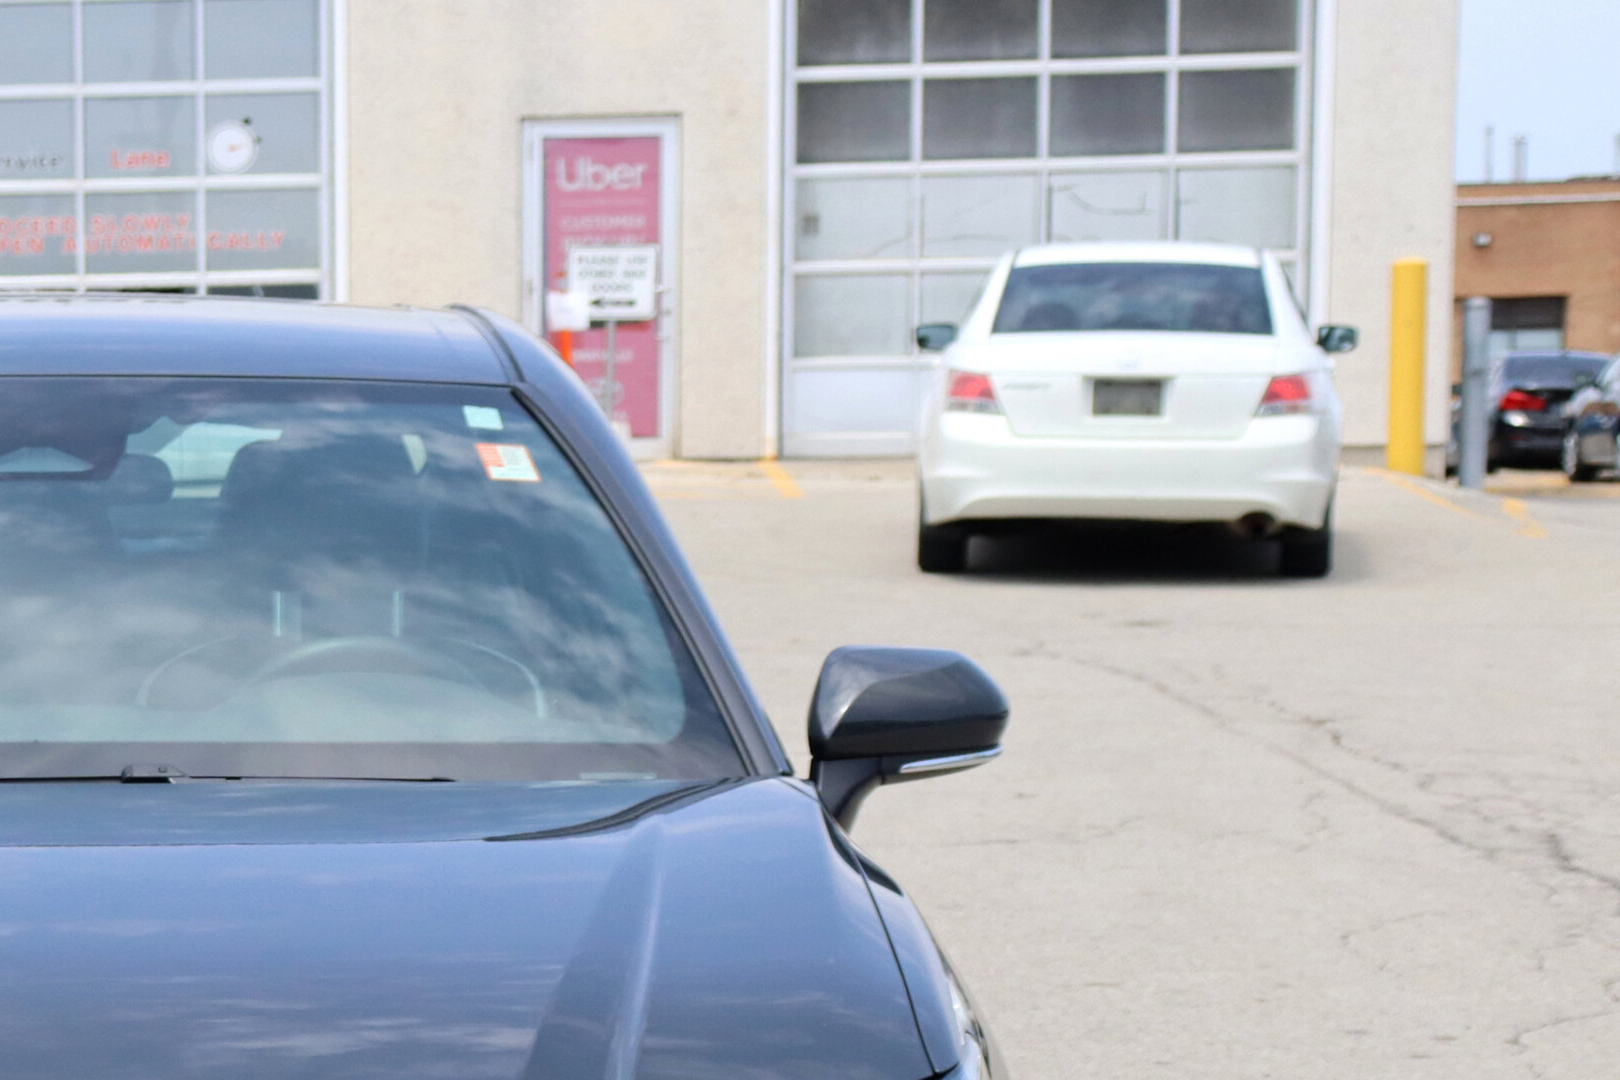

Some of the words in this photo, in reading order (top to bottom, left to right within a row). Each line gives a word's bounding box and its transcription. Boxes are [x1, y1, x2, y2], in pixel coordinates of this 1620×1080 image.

[110, 149, 170, 170] Lane
[557, 156, 648, 191] Uber
[93, 214, 191, 236] SLOWLY
[63, 230, 285, 254] AUTOMATICALLY
